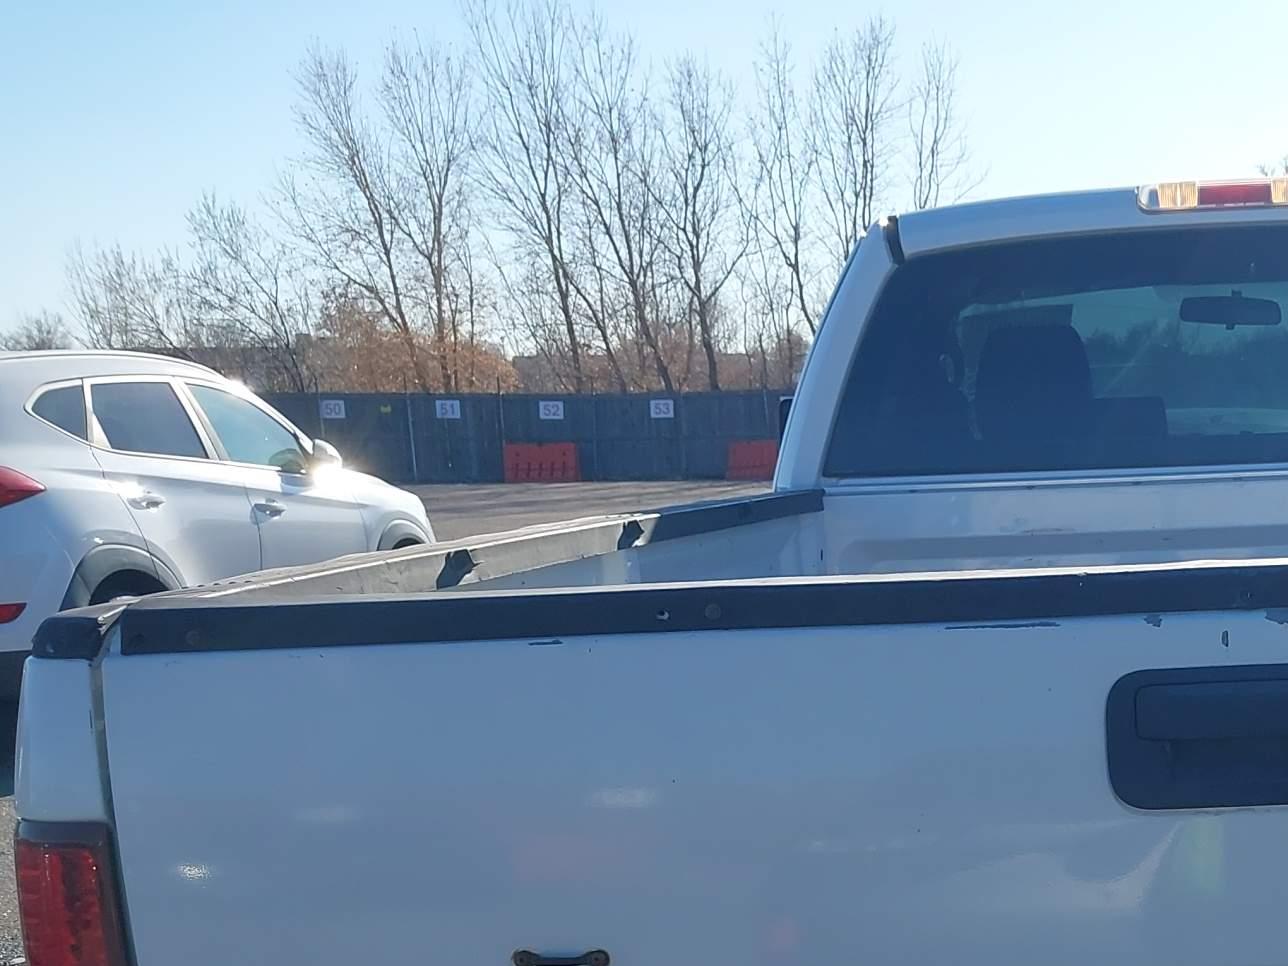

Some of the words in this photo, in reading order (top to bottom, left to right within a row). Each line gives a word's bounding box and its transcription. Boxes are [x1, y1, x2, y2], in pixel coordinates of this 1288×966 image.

[324, 401, 342, 416] 50
[440, 401, 456, 416] 51
[543, 403, 560, 417] 52
[654, 402, 671, 416] 53
